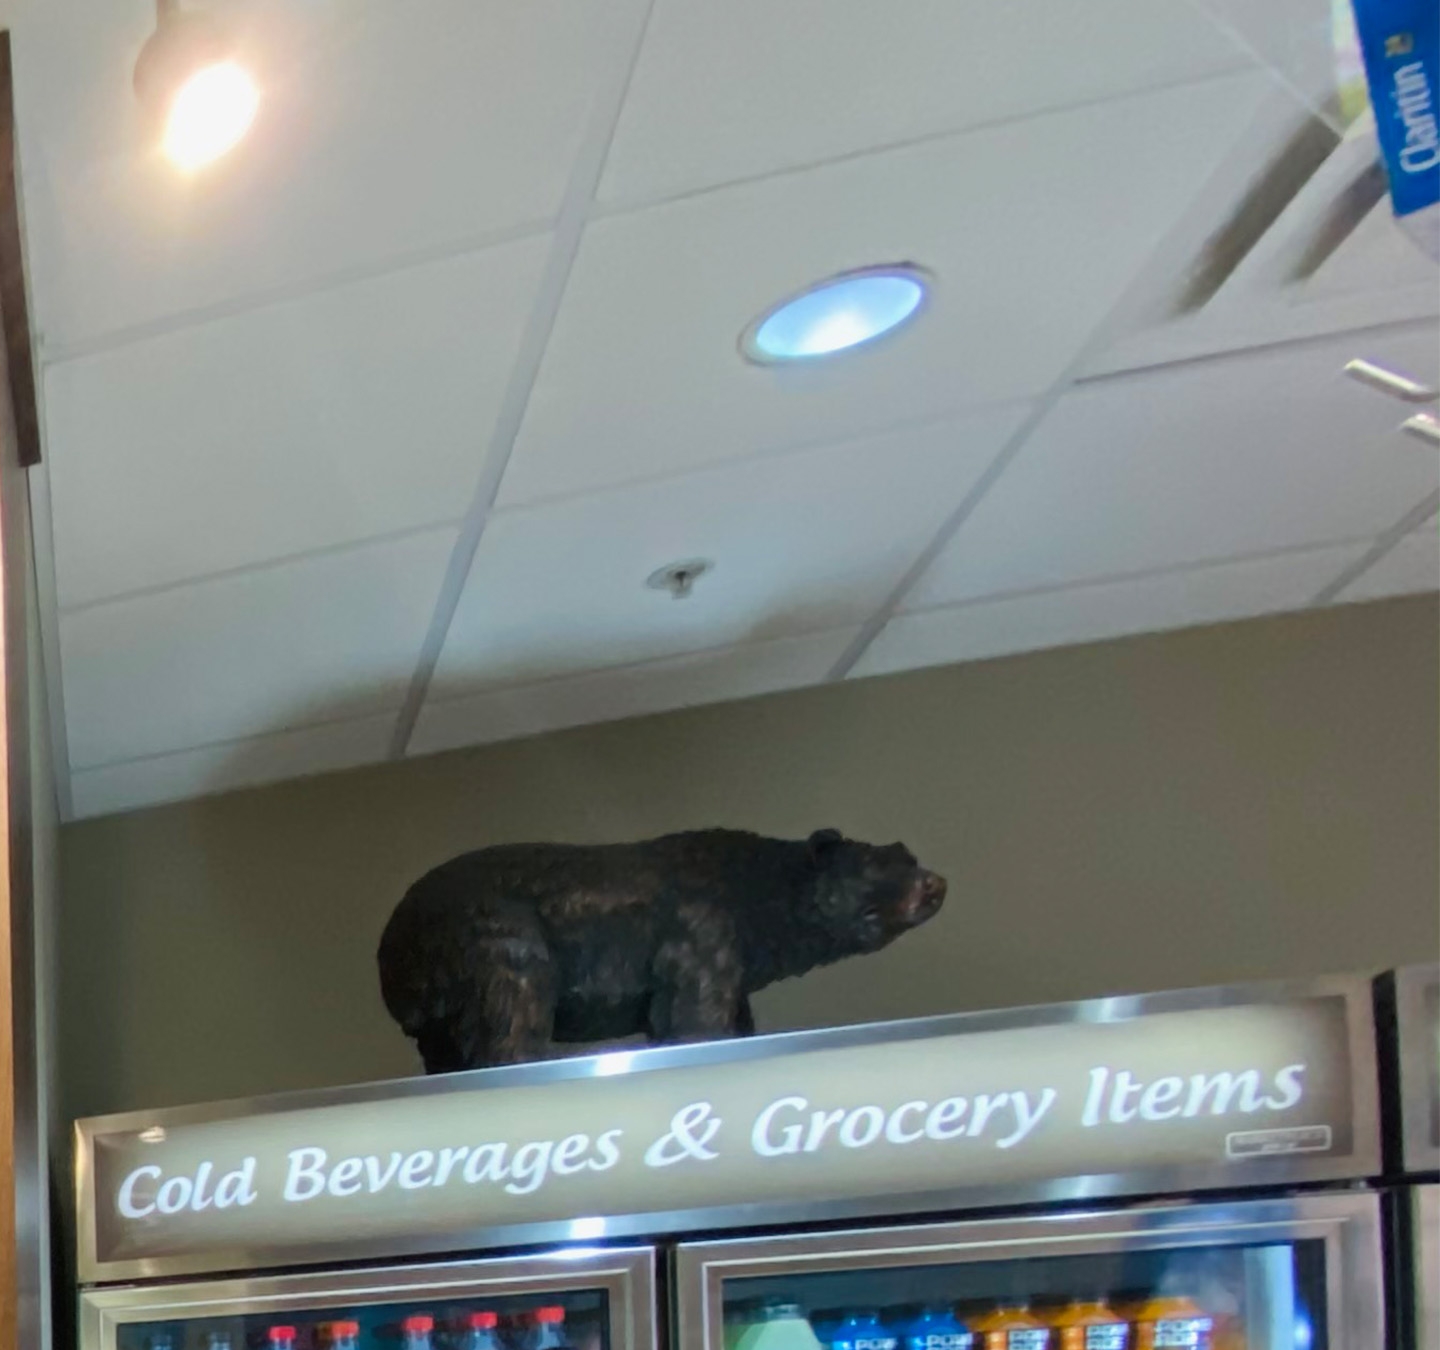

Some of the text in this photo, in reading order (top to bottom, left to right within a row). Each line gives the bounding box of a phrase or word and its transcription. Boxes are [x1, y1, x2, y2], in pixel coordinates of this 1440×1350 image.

[117, 1058, 1306, 1220] Cold Beverages & Grocery Items
